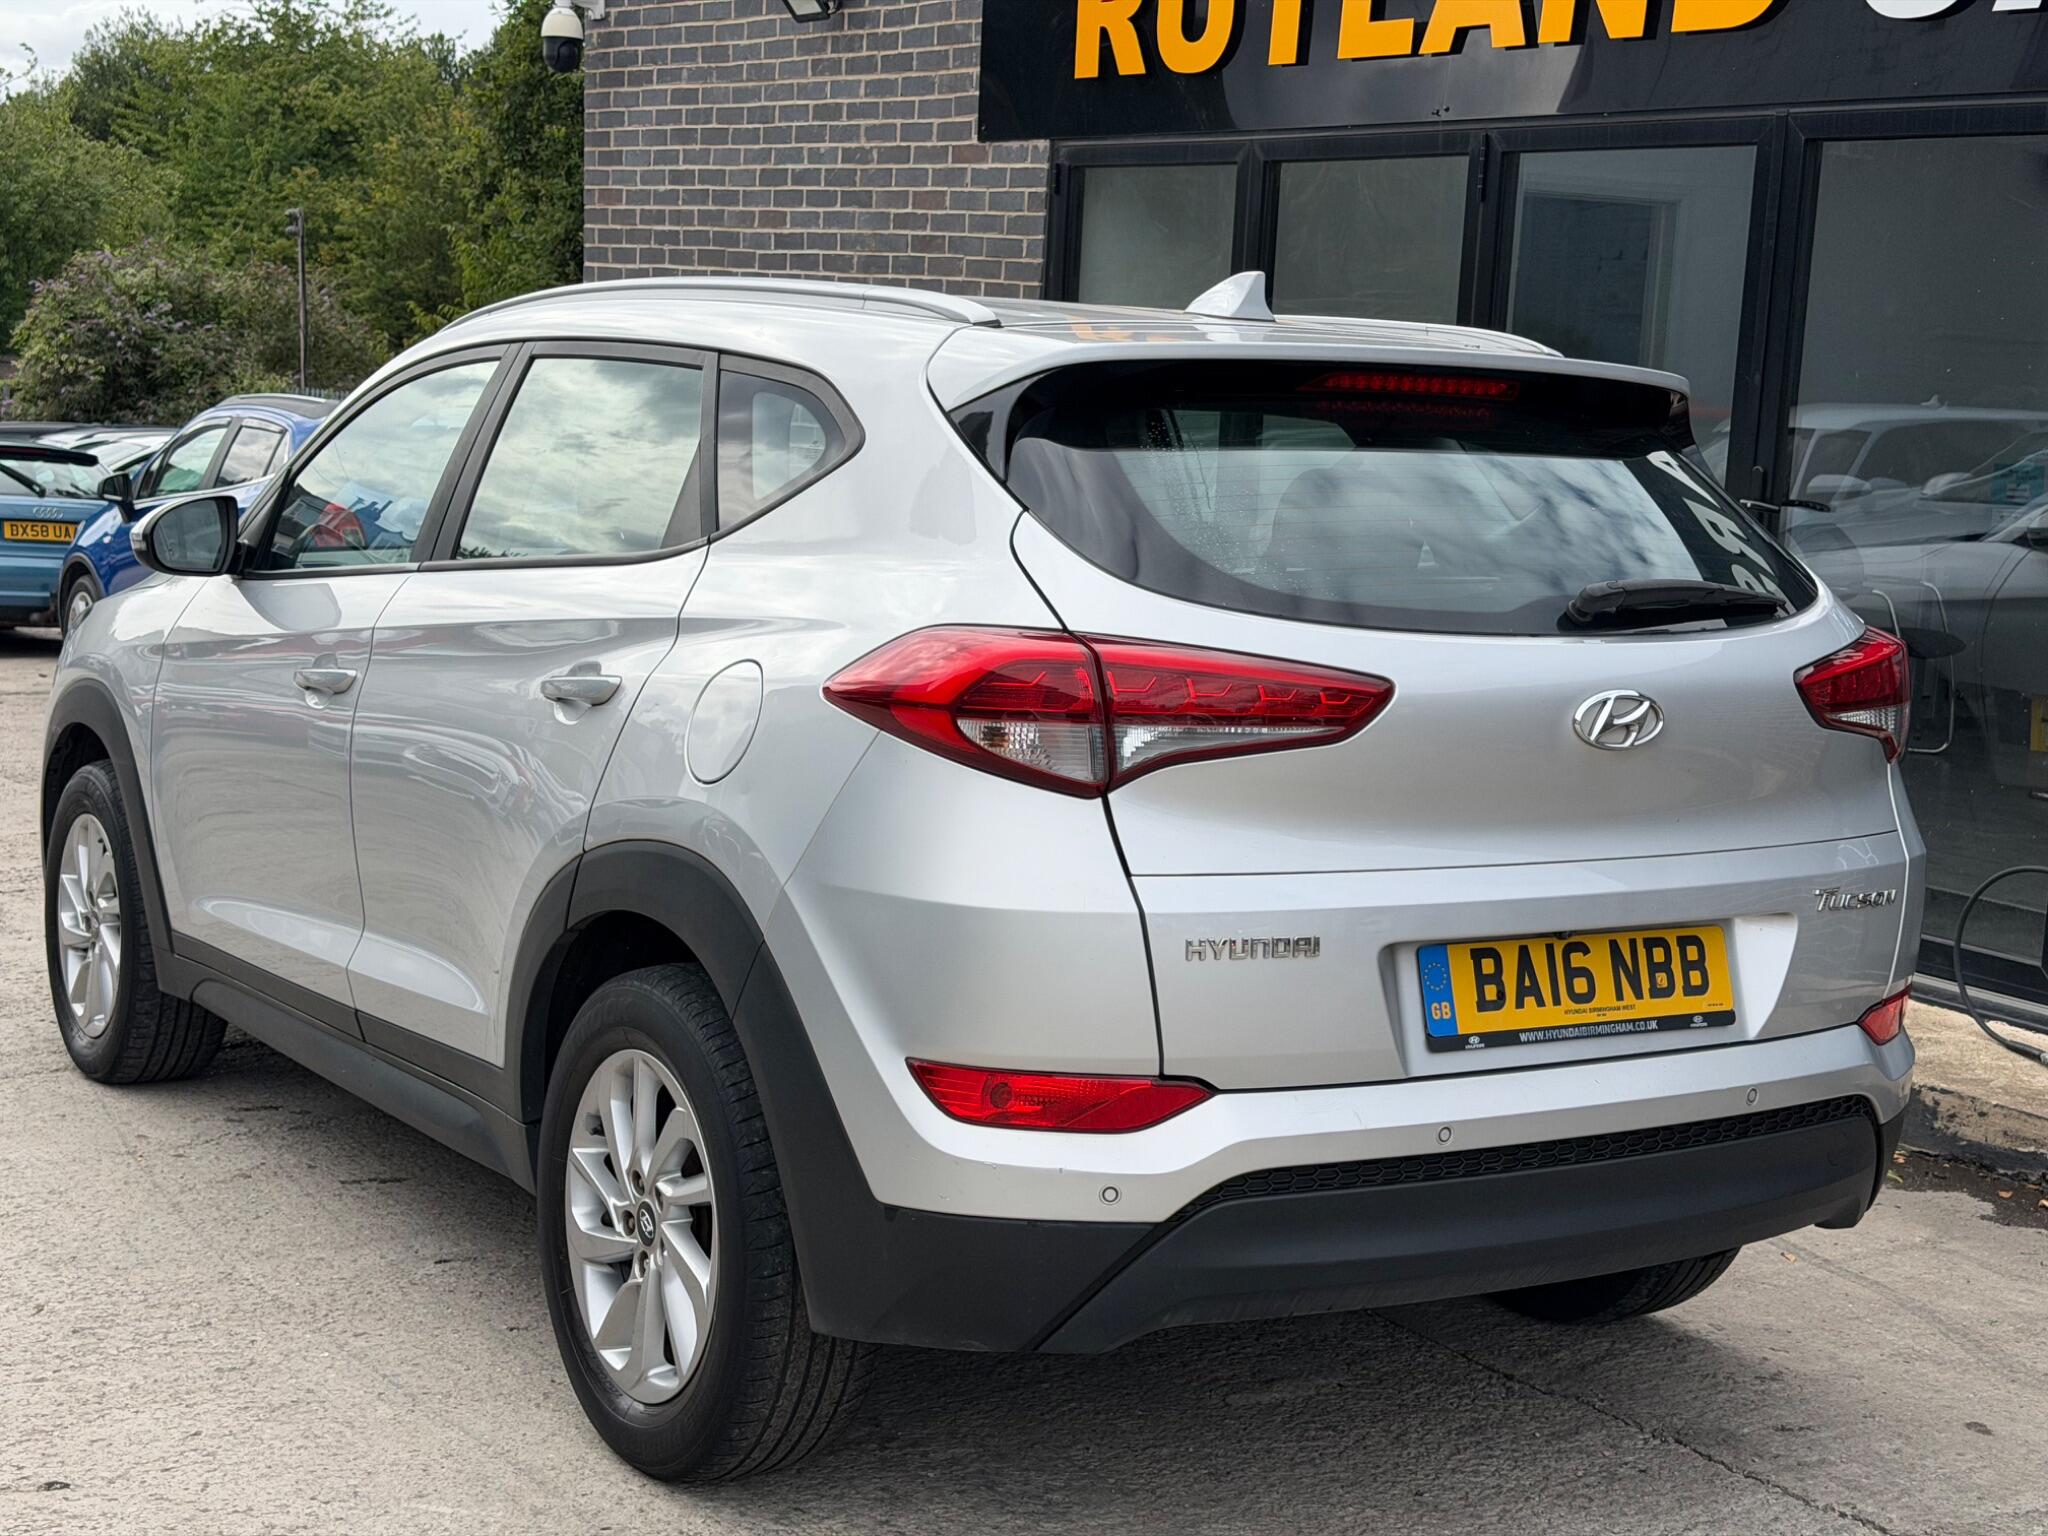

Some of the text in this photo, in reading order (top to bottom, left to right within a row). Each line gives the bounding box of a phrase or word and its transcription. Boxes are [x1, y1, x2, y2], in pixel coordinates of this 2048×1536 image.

[1074, 0, 1770, 79] RULA
[1185, 935, 1320, 961] HYUNDAI
[1470, 935, 1709, 1012] BA16 NBB
[1431, 1002, 1451, 1019] GB
[1519, 1020, 1658, 1042] WWW.HYUNDAIBIRMINGHAM.CO.UK
